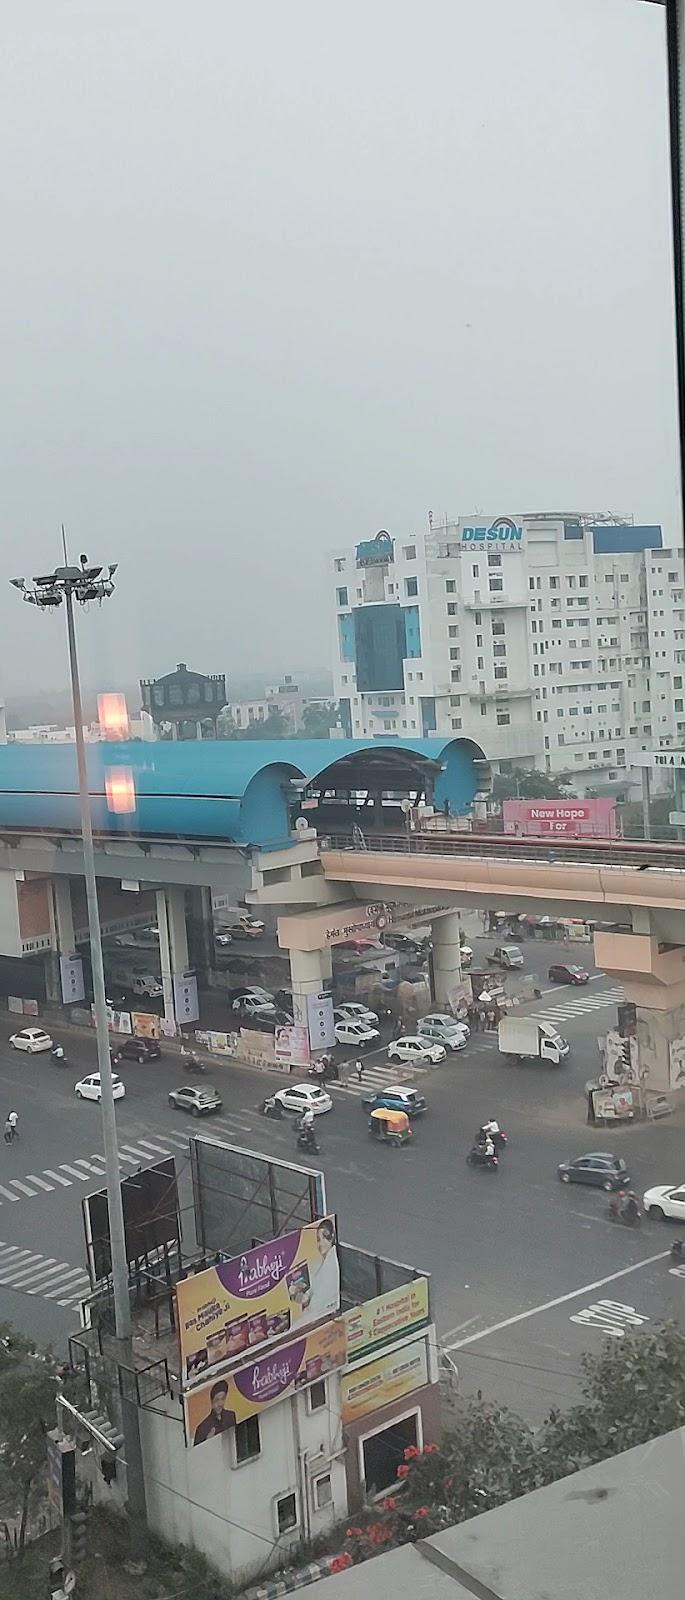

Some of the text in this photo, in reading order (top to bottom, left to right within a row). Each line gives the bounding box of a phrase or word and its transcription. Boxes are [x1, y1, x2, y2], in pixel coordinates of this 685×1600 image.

[462, 527, 523, 541] DESUN
[461, 542, 523, 551] HOSPITAL
[531, 808, 585, 820] New Hope
[550, 822, 567, 831] For
[569, 1299, 651, 1337] STOP
